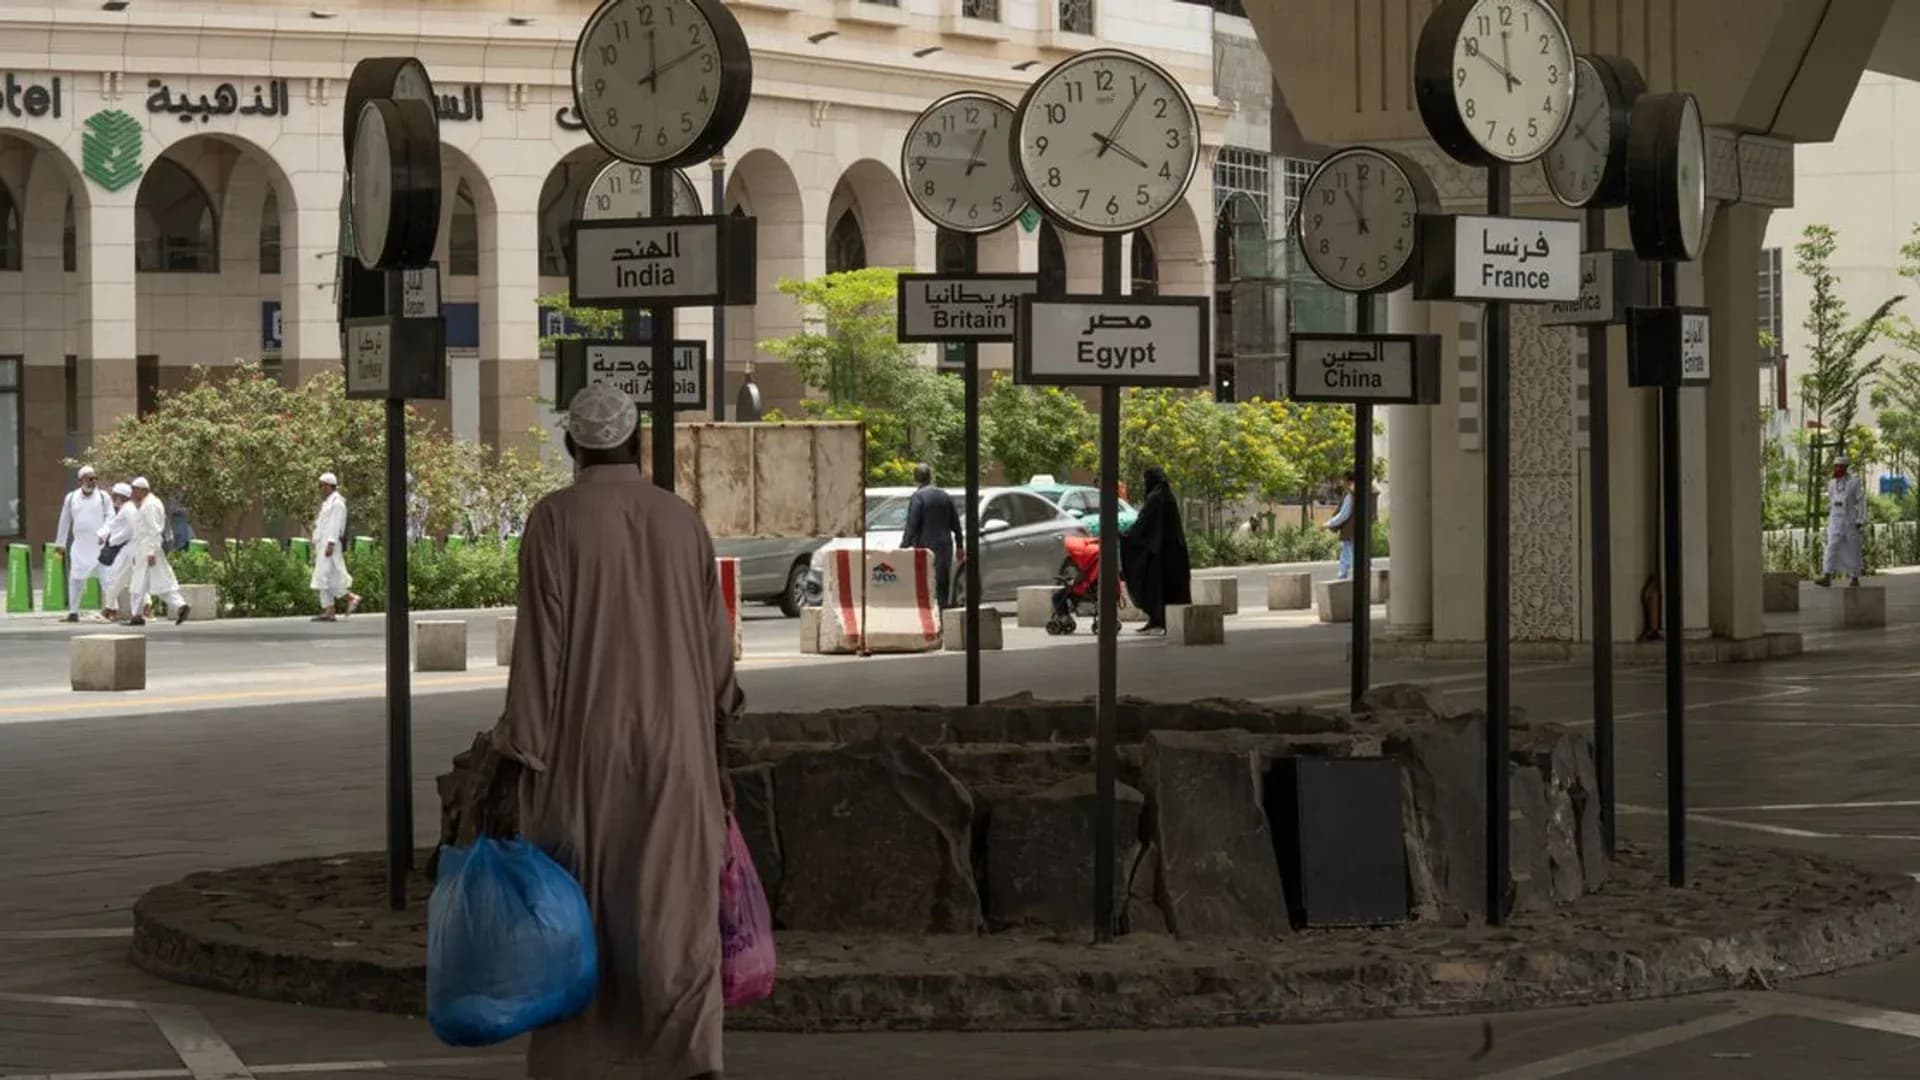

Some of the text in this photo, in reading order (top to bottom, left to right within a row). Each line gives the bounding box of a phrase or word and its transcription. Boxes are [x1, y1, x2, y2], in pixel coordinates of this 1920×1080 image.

[636, 5, 653, 26] 12
[666, 6, 674, 26] 1
[1477, 15, 1491, 36] 11
[1497, 6, 1512, 26] 12
[1523, 12, 1529, 32] 1
[613, 21, 629, 42] 11
[688, 24, 700, 45] 2
[1463, 36, 1479, 57] 10
[1539, 35, 1550, 54] 2
[601, 45, 618, 66] 10
[702, 54, 713, 73] 3
[1093, 70, 1113, 91] 12
[1457, 68, 1466, 88] 9
[1547, 65, 1558, 84] 3
[0, 72, 61, 119] tel
[594, 79, 606, 97] 9
[697, 86, 707, 104] 4
[1064, 81, 1083, 102] 11
[147, 79, 289, 123] الذهبية
[1153, 98, 1168, 119] 2
[1465, 99, 1476, 118] 8
[1543, 96, 1552, 113] 4
[607, 107, 618, 127] 8
[681, 112, 692, 133] 5
[942, 115, 955, 132] 11
[965, 107, 979, 124] 12
[1044, 103, 1066, 124] 10
[632, 124, 643, 145] 7
[656, 127, 668, 146] 6
[1486, 121, 1496, 140] 7
[1507, 127, 1517, 146] 6
[1527, 118, 1538, 138] 5
[925, 131, 942, 148] 10
[1036, 136, 1048, 156] 9
[1165, 129, 1180, 149] 3
[917, 156, 926, 172] 9
[1158, 160, 1171, 180] 4
[1356, 163, 1369, 181] 12
[609, 176, 622, 193] 11
[629, 167, 642, 184] 12
[1048, 167, 1061, 187] 8
[1336, 172, 1348, 189] 11
[924, 180, 935, 196] 8
[1136, 184, 1150, 206] 5
[1320, 188, 1335, 205] 10
[1395, 187, 1405, 203] 2
[595, 194, 611, 211] 10
[947, 198, 957, 213] 7
[992, 195, 1003, 213] 5
[1077, 189, 1090, 210] 7
[1105, 196, 1119, 215] 6
[968, 203, 978, 219] 6
[1402, 212, 1411, 228] 3
[1313, 214, 1323, 230] 9
[612, 231, 680, 261] الهند
[1320, 238, 1330, 254] 8
[1394, 238, 1403, 252] 4
[1482, 228, 1550, 262] فرنسا
[1339, 256, 1348, 271] 7
[1356, 262, 1367, 278] 6
[1378, 255, 1388, 271] 5
[617, 264, 675, 288] India
[1482, 264, 1550, 289] France
[925, 283, 1014, 309] بريطانيا
[934, 310, 1006, 329] Britain
[1081, 312, 1152, 335] مصر
[593, 350, 693, 377] السودية
[1077, 340, 1156, 369] Egypt
[1322, 341, 1384, 368] الصين
[1324, 368, 1382, 388] China
